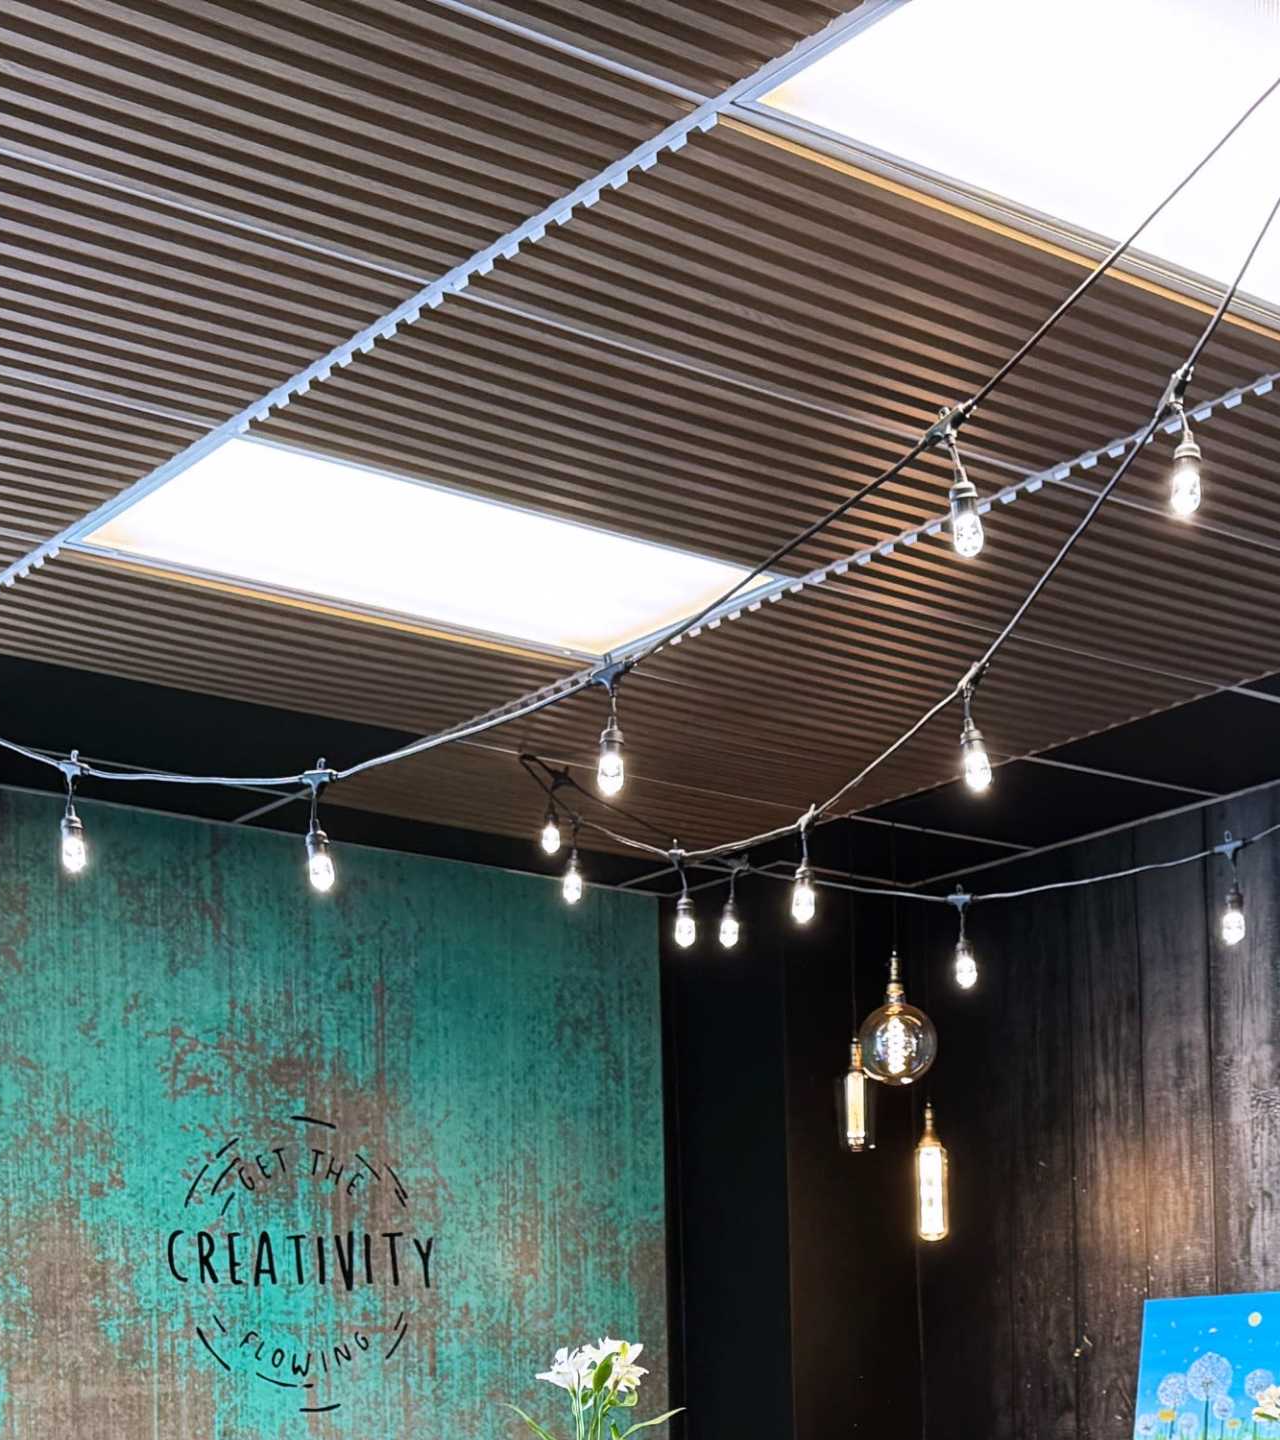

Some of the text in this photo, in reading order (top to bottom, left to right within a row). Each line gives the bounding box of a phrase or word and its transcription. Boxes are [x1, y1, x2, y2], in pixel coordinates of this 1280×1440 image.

[238, 1148, 365, 1197] GET THE
[167, 1230, 433, 1292] CREATIVITY
[240, 1331, 369, 1377] FLOWING
